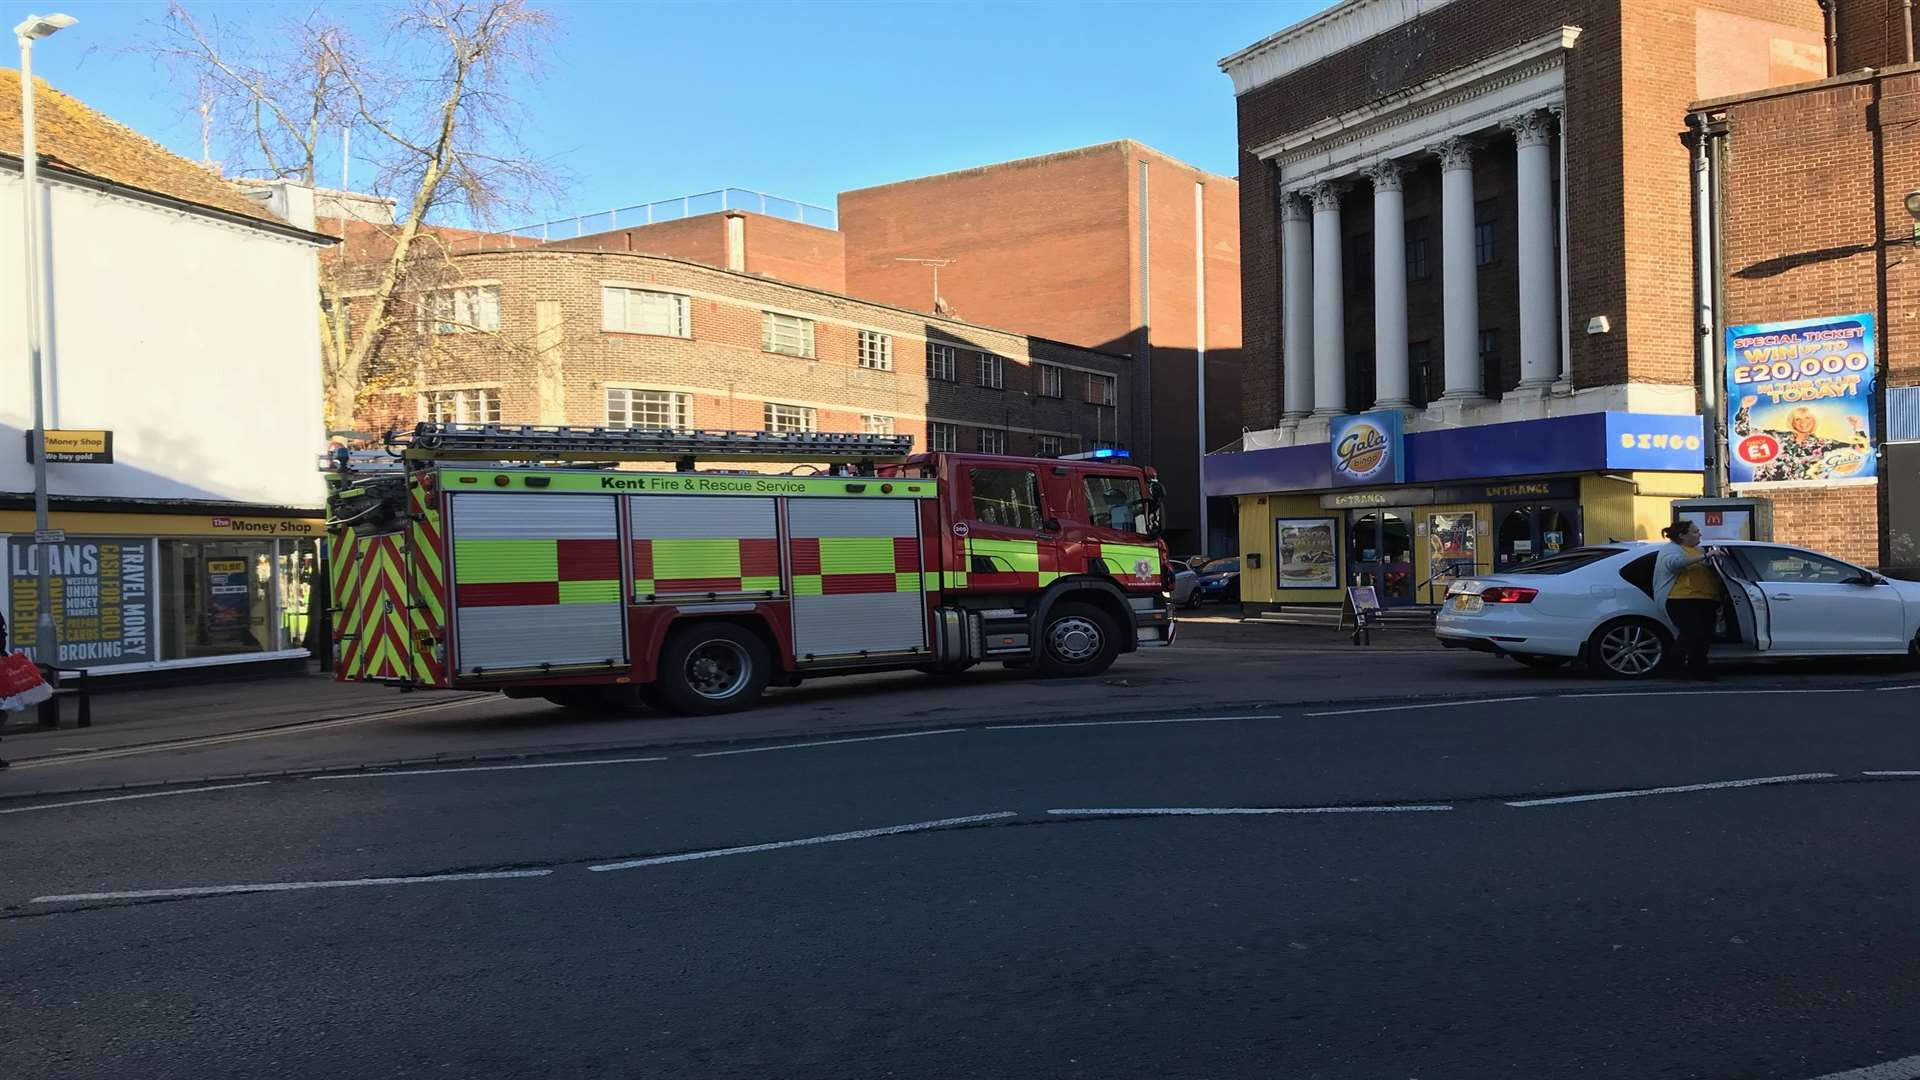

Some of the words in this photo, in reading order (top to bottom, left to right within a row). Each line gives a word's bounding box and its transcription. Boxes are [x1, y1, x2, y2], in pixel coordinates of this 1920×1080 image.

[1734, 333, 1801, 348] SPECIAL
[1802, 327, 1866, 341] TICKET
[1744, 345, 1799, 364] WIN
[49, 439, 77, 447] Money
[80, 438, 102, 447] Shop
[1622, 433, 1700, 450] BINGO
[59, 453, 74, 461] buy
[75, 453, 93, 461] gold
[1336, 430, 1387, 472] Gala
[601, 477, 645, 489] Kent
[651, 478, 679, 490] Fire
[684, 479, 695, 490] &
[699, 479, 752, 491] Rescue
[756, 480, 806, 492] Service
[1486, 484, 1549, 496] ENTRANCE
[1335, 494, 1386, 505] ENTRANCE
[213, 518, 230, 526] The
[232, 520, 276, 533] Money
[281, 521, 312, 534] Shop
[101, 544, 119, 577] CASH
[122, 545, 145, 600] TRAVEL
[66, 585, 98, 597] UNION
[66, 597, 98, 608] MONEY
[102, 607, 121, 639] GOLD
[123, 604, 146, 654] MONEY
[60, 641, 121, 661] BROKING
